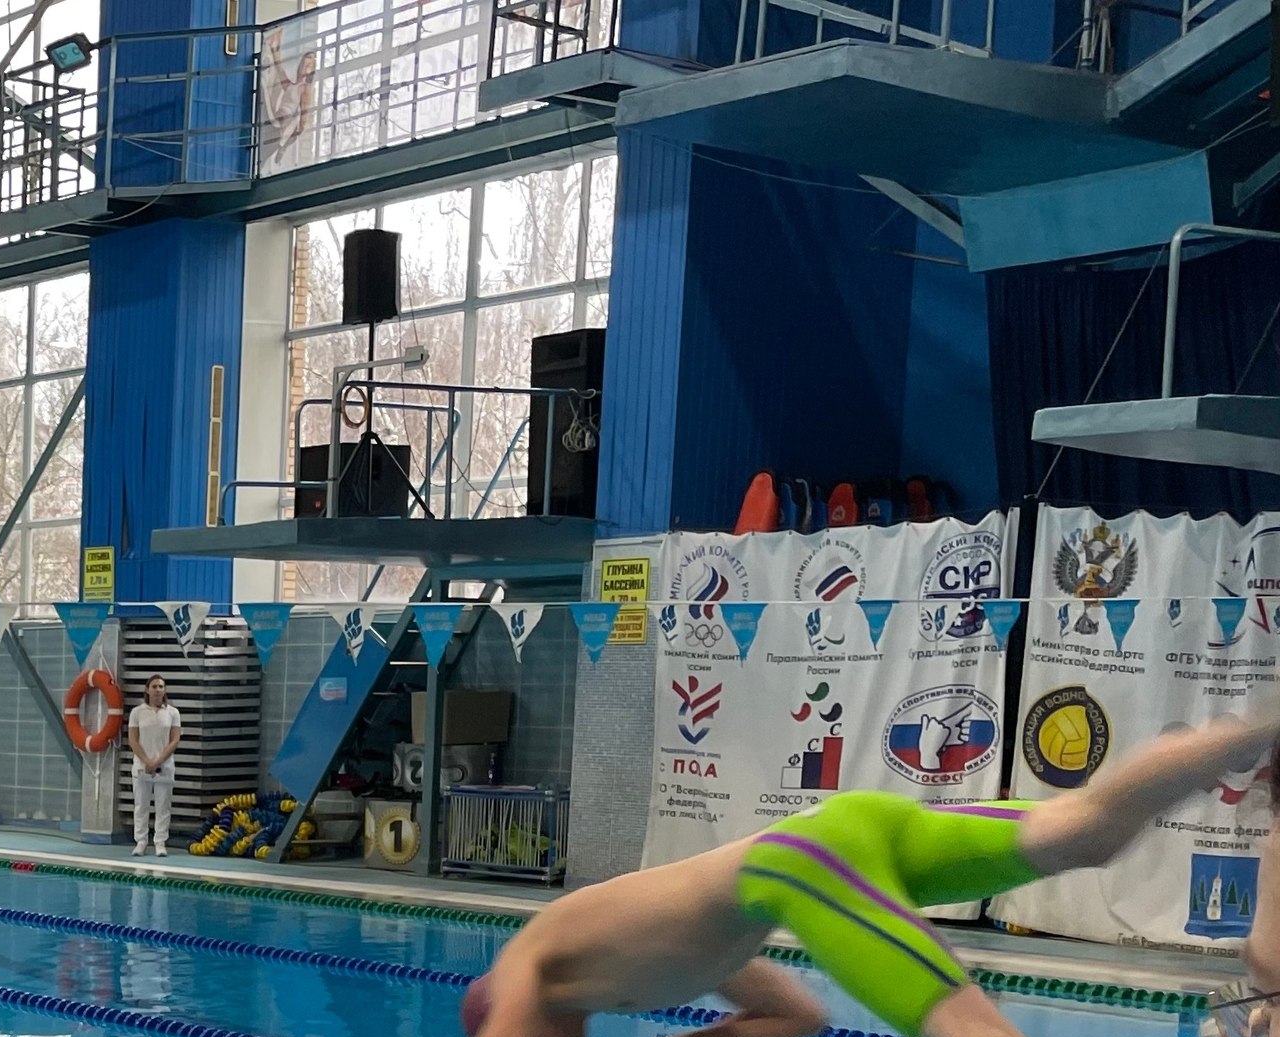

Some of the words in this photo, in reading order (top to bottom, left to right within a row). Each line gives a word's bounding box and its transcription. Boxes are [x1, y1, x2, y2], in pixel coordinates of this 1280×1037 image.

[606, 564, 644, 577] ГЛУБИНА
[603, 578, 645, 592] БАССЕЙНА
[806, 665, 841, 676] России
[389, 819, 403, 853] 1
